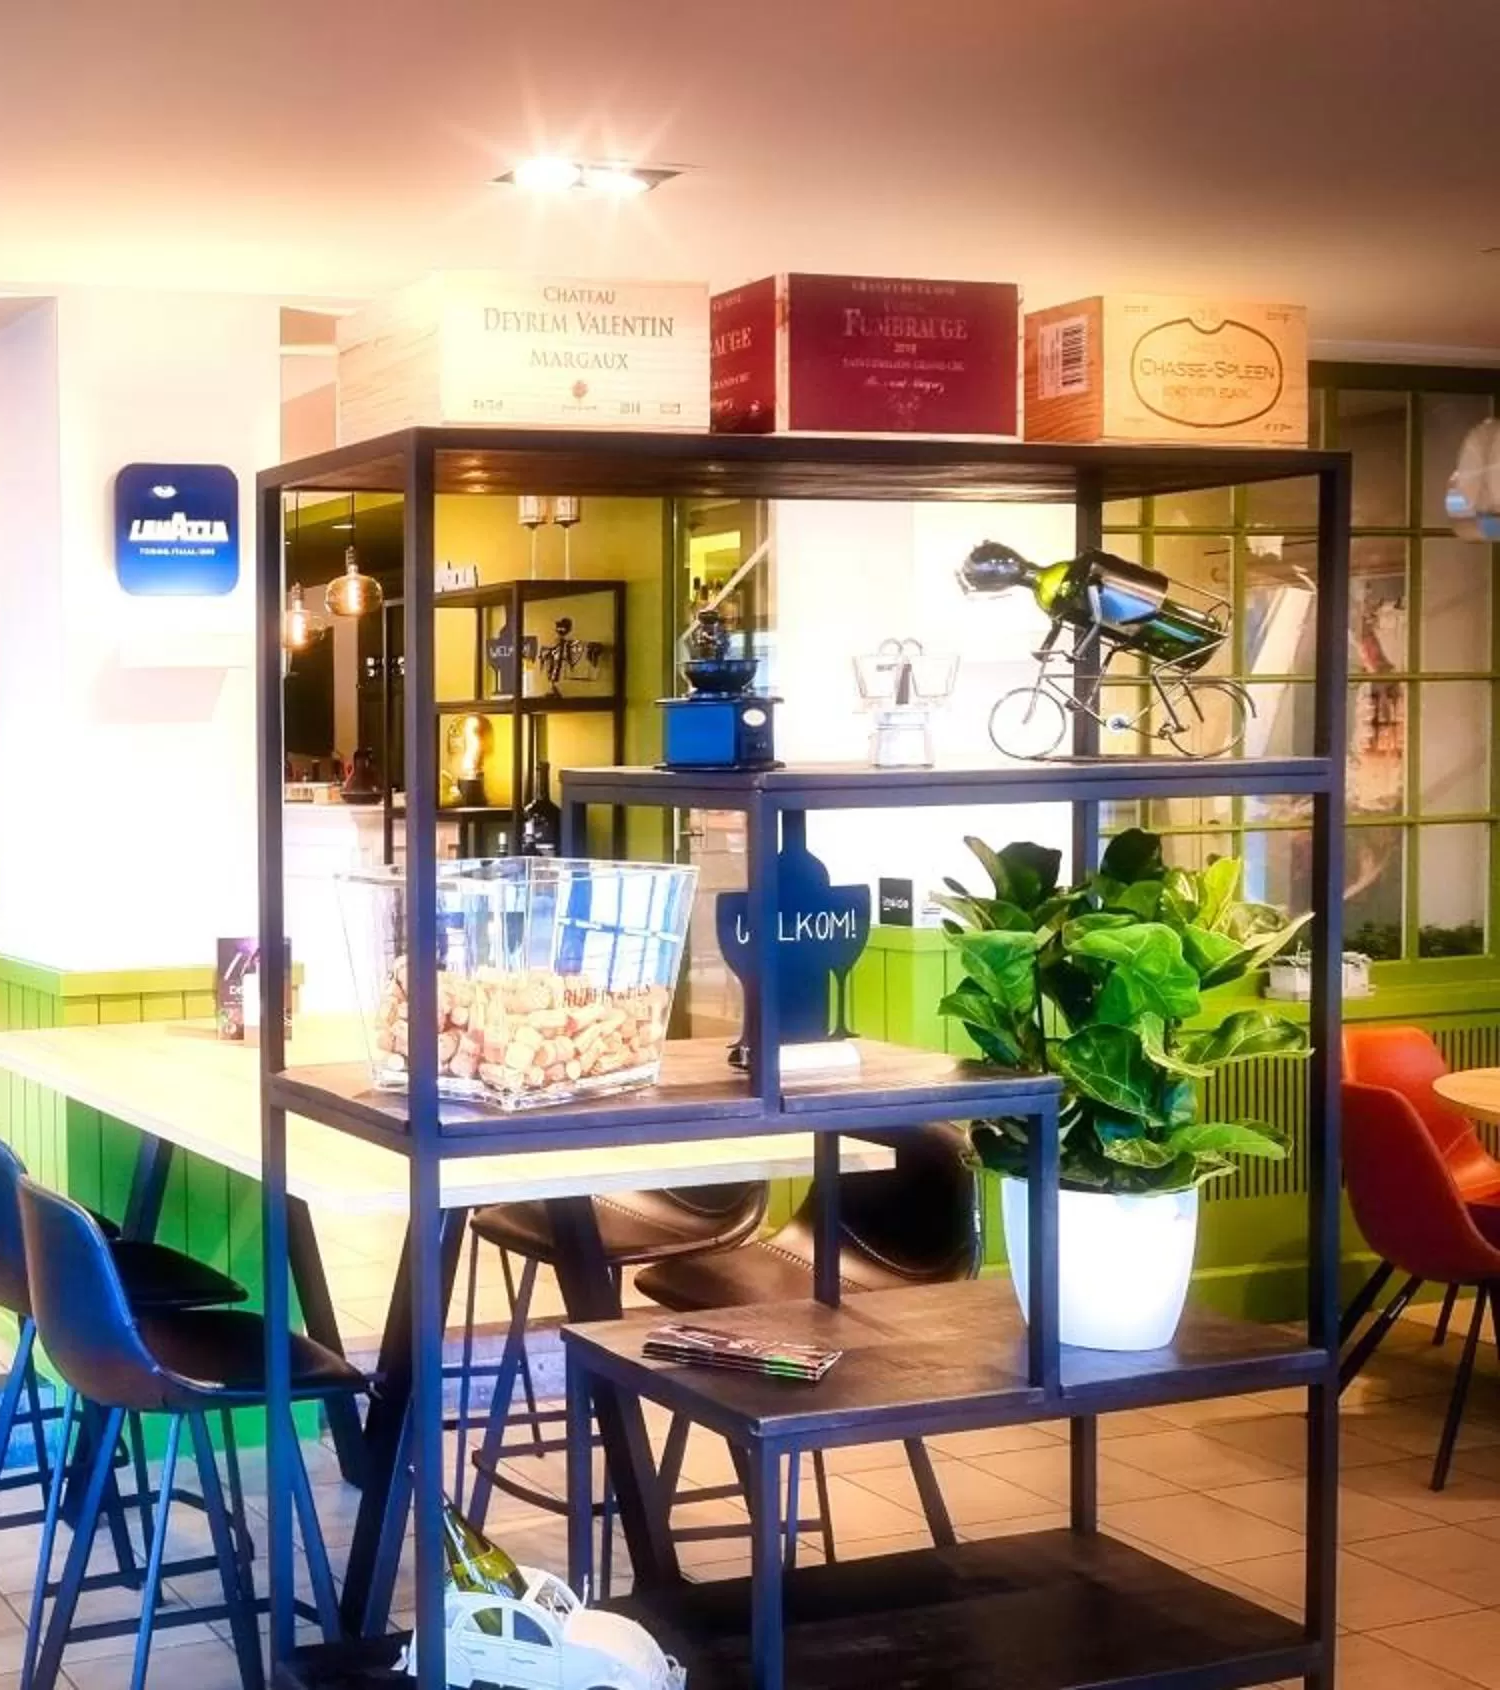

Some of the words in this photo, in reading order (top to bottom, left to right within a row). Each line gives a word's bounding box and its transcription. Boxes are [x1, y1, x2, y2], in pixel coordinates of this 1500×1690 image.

[483, 307, 569, 333] DEYREM
[577, 311, 675, 338] VALENTIN
[529, 349, 629, 371] MARGAUX
[129, 512, 229, 541] LAVAZZA
[735, 906, 858, 945] LKOM!
